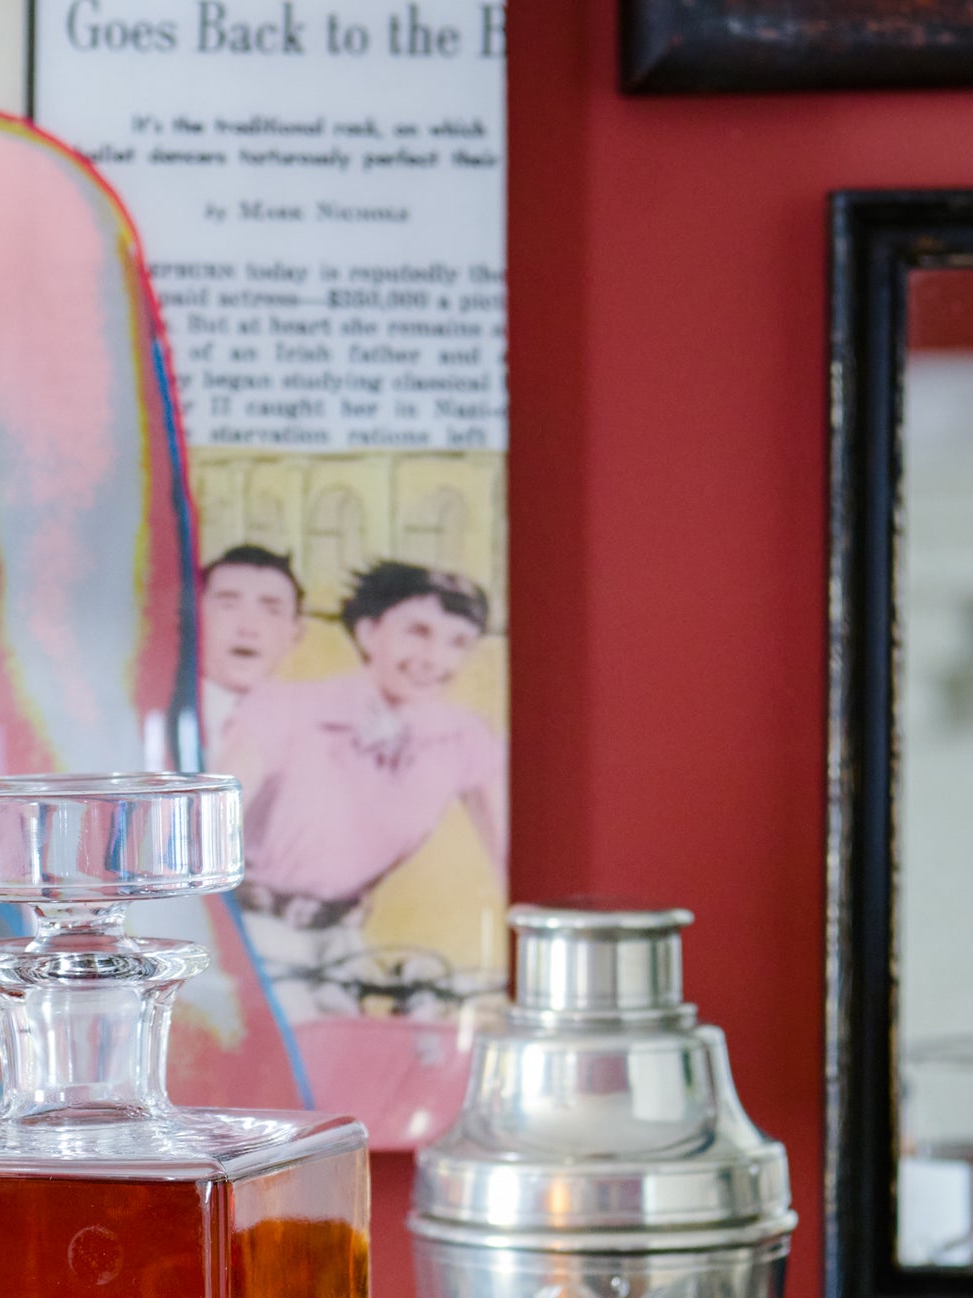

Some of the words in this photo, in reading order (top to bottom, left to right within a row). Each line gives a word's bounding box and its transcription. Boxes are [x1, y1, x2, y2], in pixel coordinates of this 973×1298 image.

[65, 0, 178, 52] Goes
[196, 0, 305, 55] Back
[326, 14, 370, 56] to
[388, 2, 461, 58] the
[172, 117, 205, 135] the
[214, 116, 325, 137] traditional
[429, 119, 487, 139] which
[363, 148, 439, 171] perfect
[245, 262, 308, 284] today
[269, 316, 331, 336] heart
[340, 317, 378, 337] she
[349, 343, 421, 365] father
[438, 345, 479, 366] and
